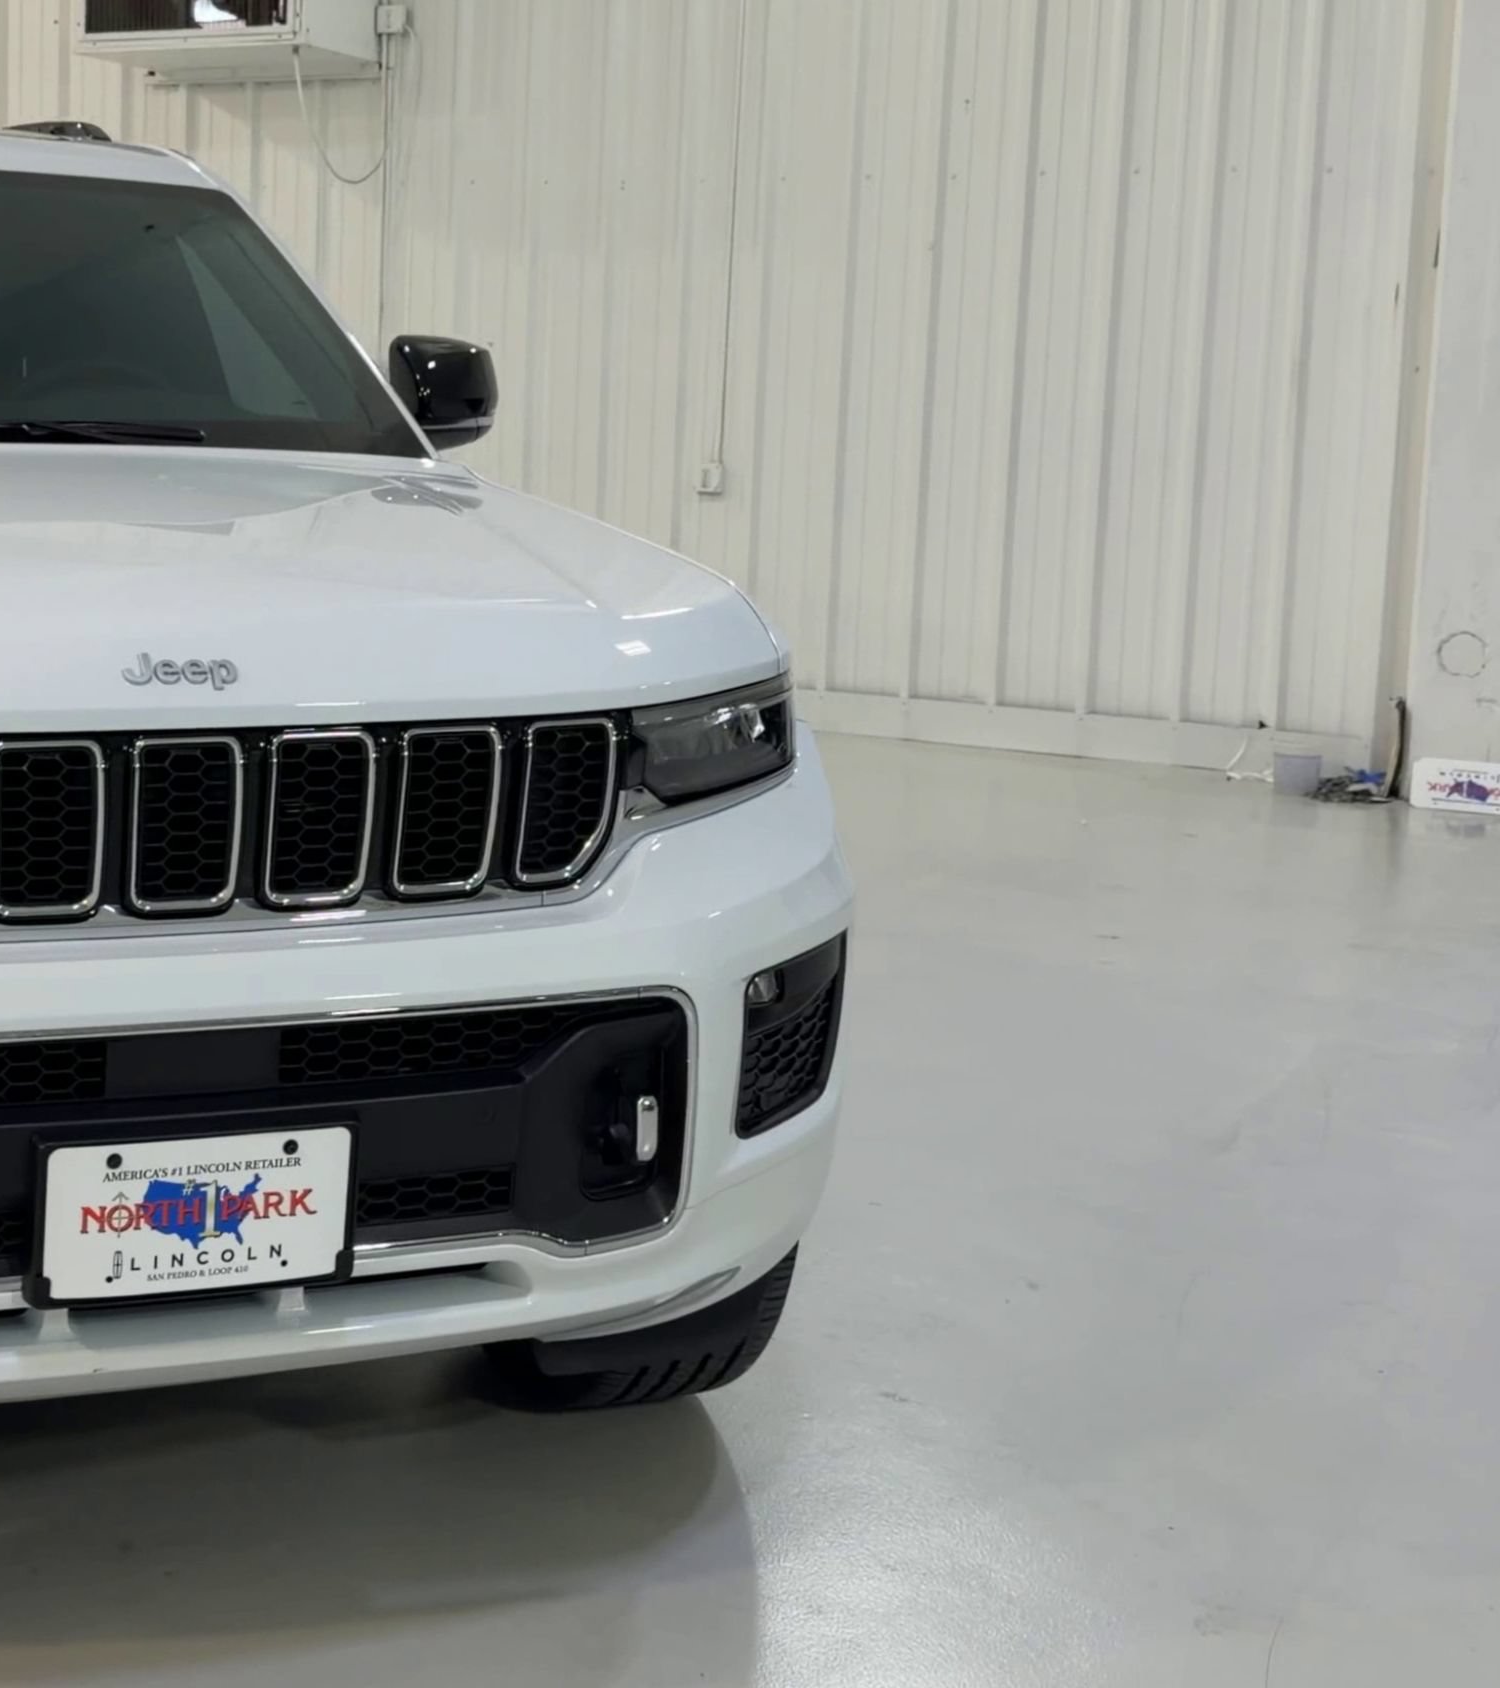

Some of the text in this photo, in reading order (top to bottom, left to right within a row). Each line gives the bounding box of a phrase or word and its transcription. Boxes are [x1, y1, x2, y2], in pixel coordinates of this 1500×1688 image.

[121, 652, 238, 691] Jeep
[103, 1157, 301, 1183] AMERICA'S #1 LINCOLN RETAILER
[80, 1188, 317, 1234] NORTH PARK
[130, 1244, 282, 1271] LINCOLN
